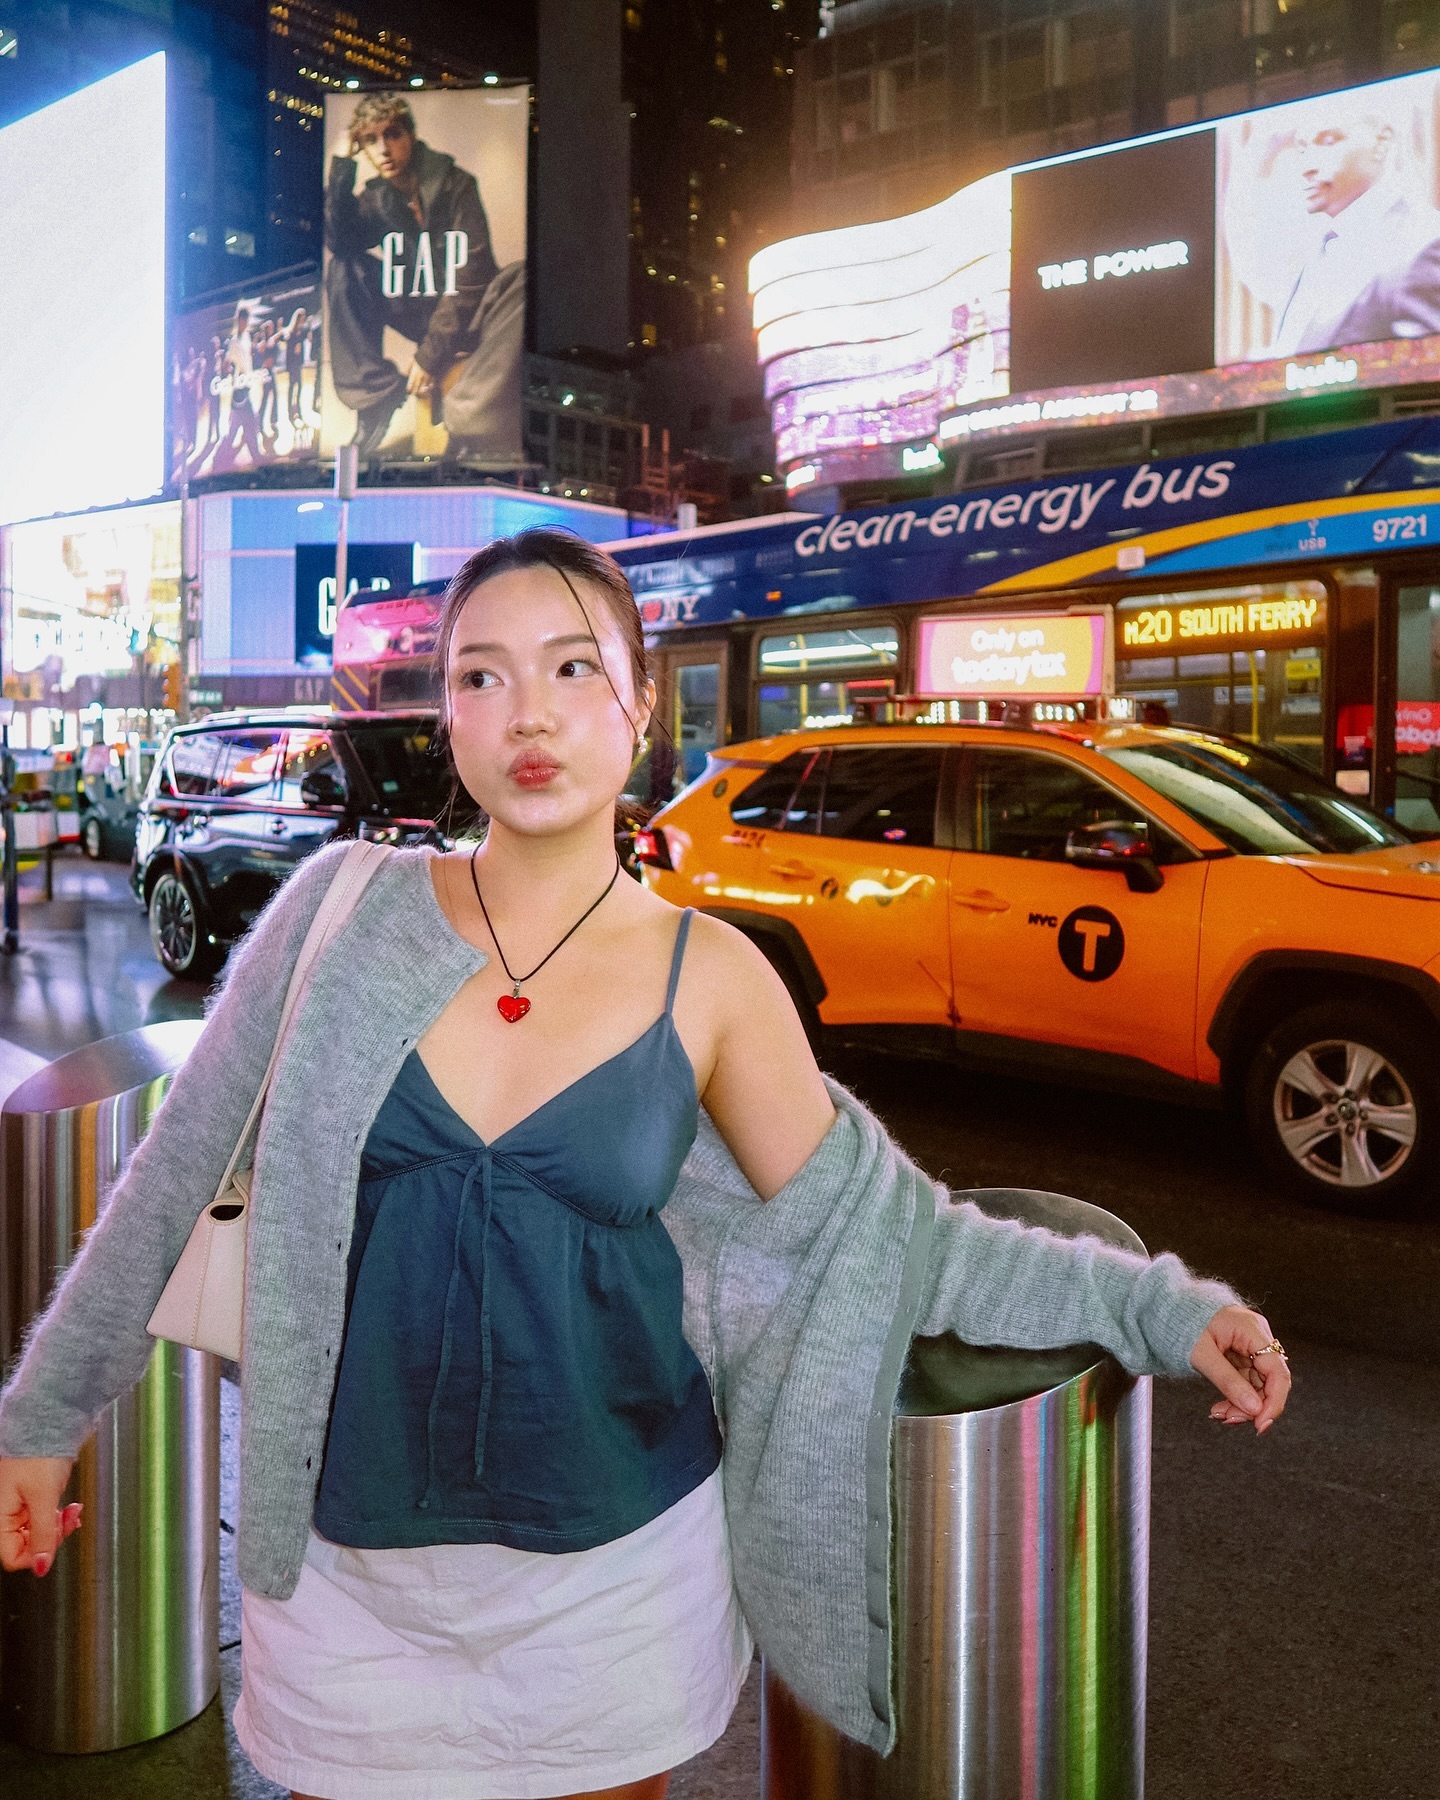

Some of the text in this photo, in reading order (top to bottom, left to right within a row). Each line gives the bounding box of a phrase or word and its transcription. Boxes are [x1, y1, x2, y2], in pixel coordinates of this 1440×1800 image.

[382, 230, 468, 298] GAP
[1037, 240, 1189, 289] THE POWER
[795, 460, 1236, 557] clean-energy bus
[1298, 537, 1327, 551] USB
[1372, 514, 1427, 543] 9721
[664, 595, 700, 622] NY
[1179, 605, 1244, 637] SOUTH
[1248, 599, 1317, 631] FERRY
[971, 627, 1045, 652] Only on
[1028, 912, 1111, 972] NYC T
